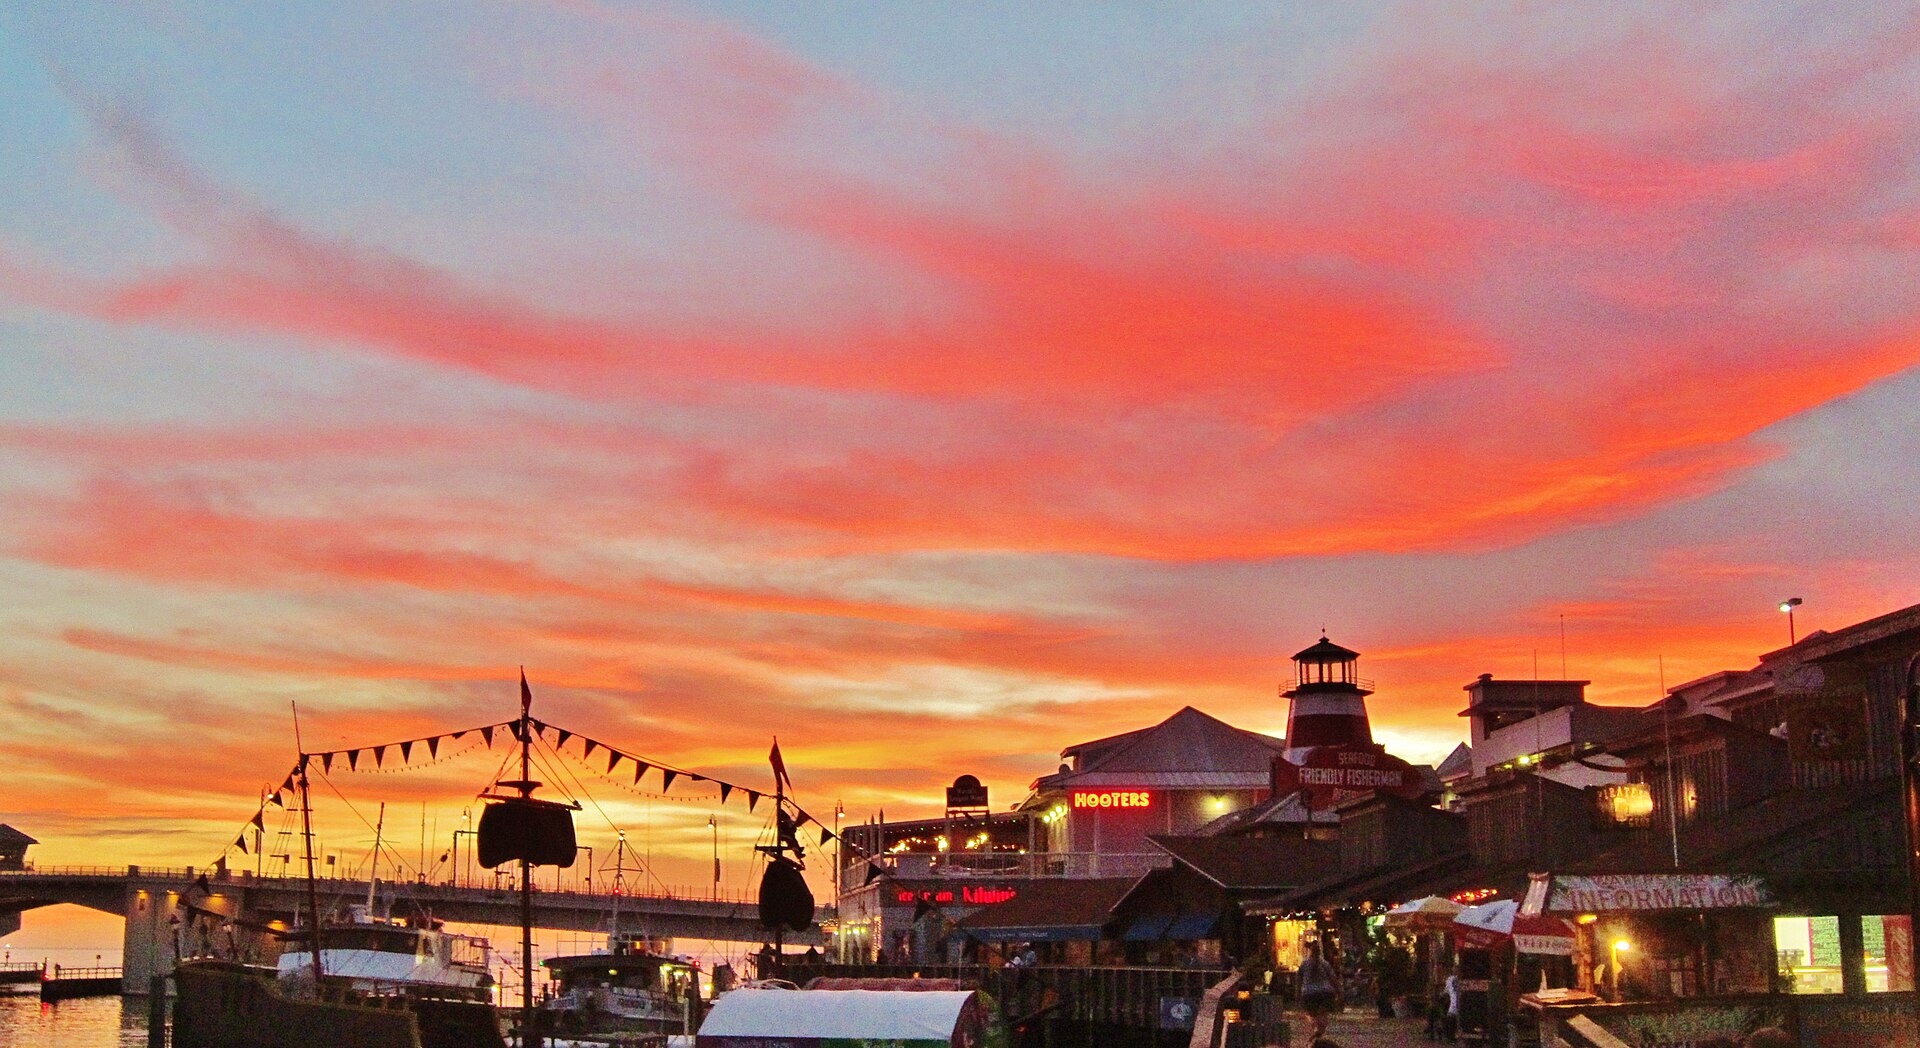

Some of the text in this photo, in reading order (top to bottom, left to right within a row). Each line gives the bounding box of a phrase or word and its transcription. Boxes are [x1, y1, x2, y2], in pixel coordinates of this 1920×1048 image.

[1338, 751, 1376, 767] SEAFOOD
[1298, 767, 1403, 787] FRIENDLY FISHERMAN
[1074, 792, 1150, 808] HOOTERS
[1570, 886, 1758, 910] INFORMATION
